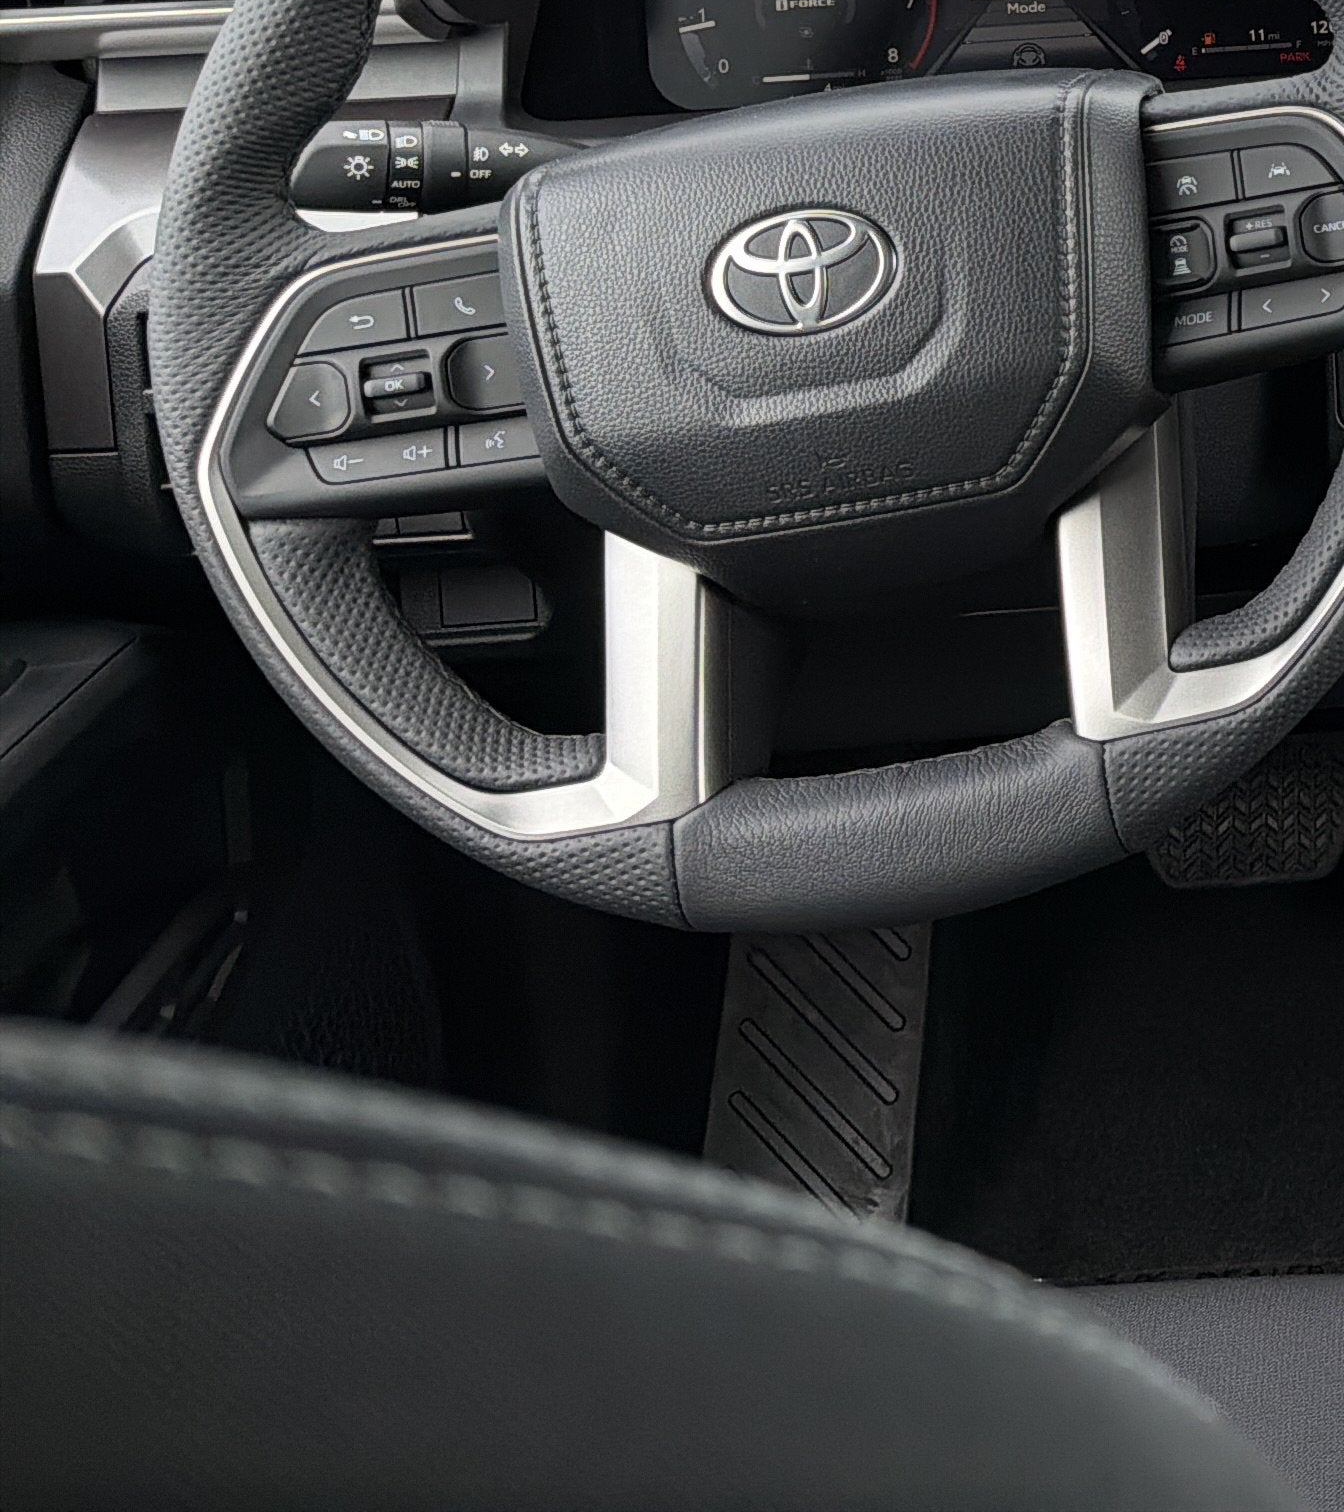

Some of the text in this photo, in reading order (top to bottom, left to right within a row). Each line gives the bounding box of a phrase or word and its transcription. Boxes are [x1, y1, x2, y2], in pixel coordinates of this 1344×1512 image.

[1007, 1, 1047, 15] Mode
[1249, 29, 1265, 42] 11
[887, 48, 899, 62] 8
[1191, 47, 1198, 55] E
[1280, 53, 1312, 63] PARK
[718, 59, 729, 73] 0
[469, 169, 492, 180] OFF
[391, 180, 420, 188] AUTO
[1171, 244, 1188, 253] MODE
[1174, 310, 1214, 326] MODE
[384, 377, 404, 392] OK
